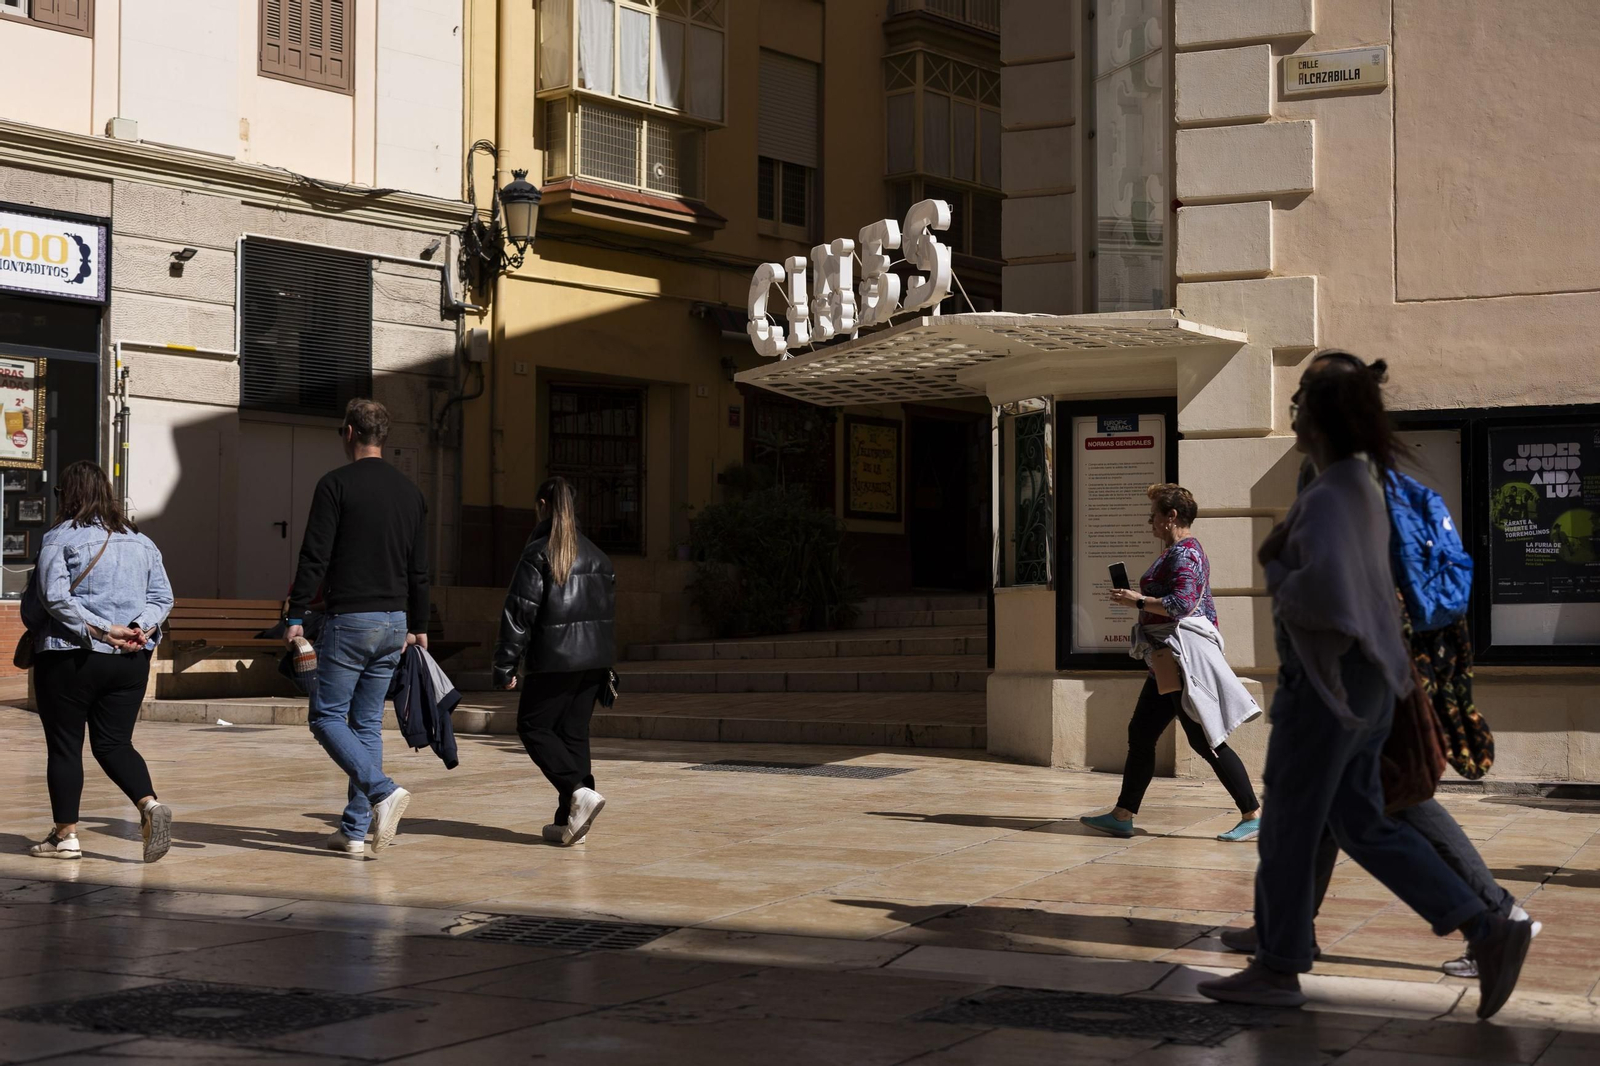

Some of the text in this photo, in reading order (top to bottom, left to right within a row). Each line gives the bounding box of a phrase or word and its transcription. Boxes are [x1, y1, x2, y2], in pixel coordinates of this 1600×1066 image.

[1298, 60, 1318, 70] CALLE
[1298, 68, 1360, 85] ALCAZABILLA
[0, 227, 69, 265] 100
[0, 259, 69, 279] ONTADITOS
[747, 199, 951, 357] CINES
[1518, 442, 1581, 458] UNDER
[1503, 456, 1581, 472] GROUND
[1530, 470, 1581, 485] ANDA
[1546, 484, 1581, 498] LUZ
[1504, 525, 1529, 533] MUERTE
[1504, 529, 1550, 538] TORREMOLINOS
